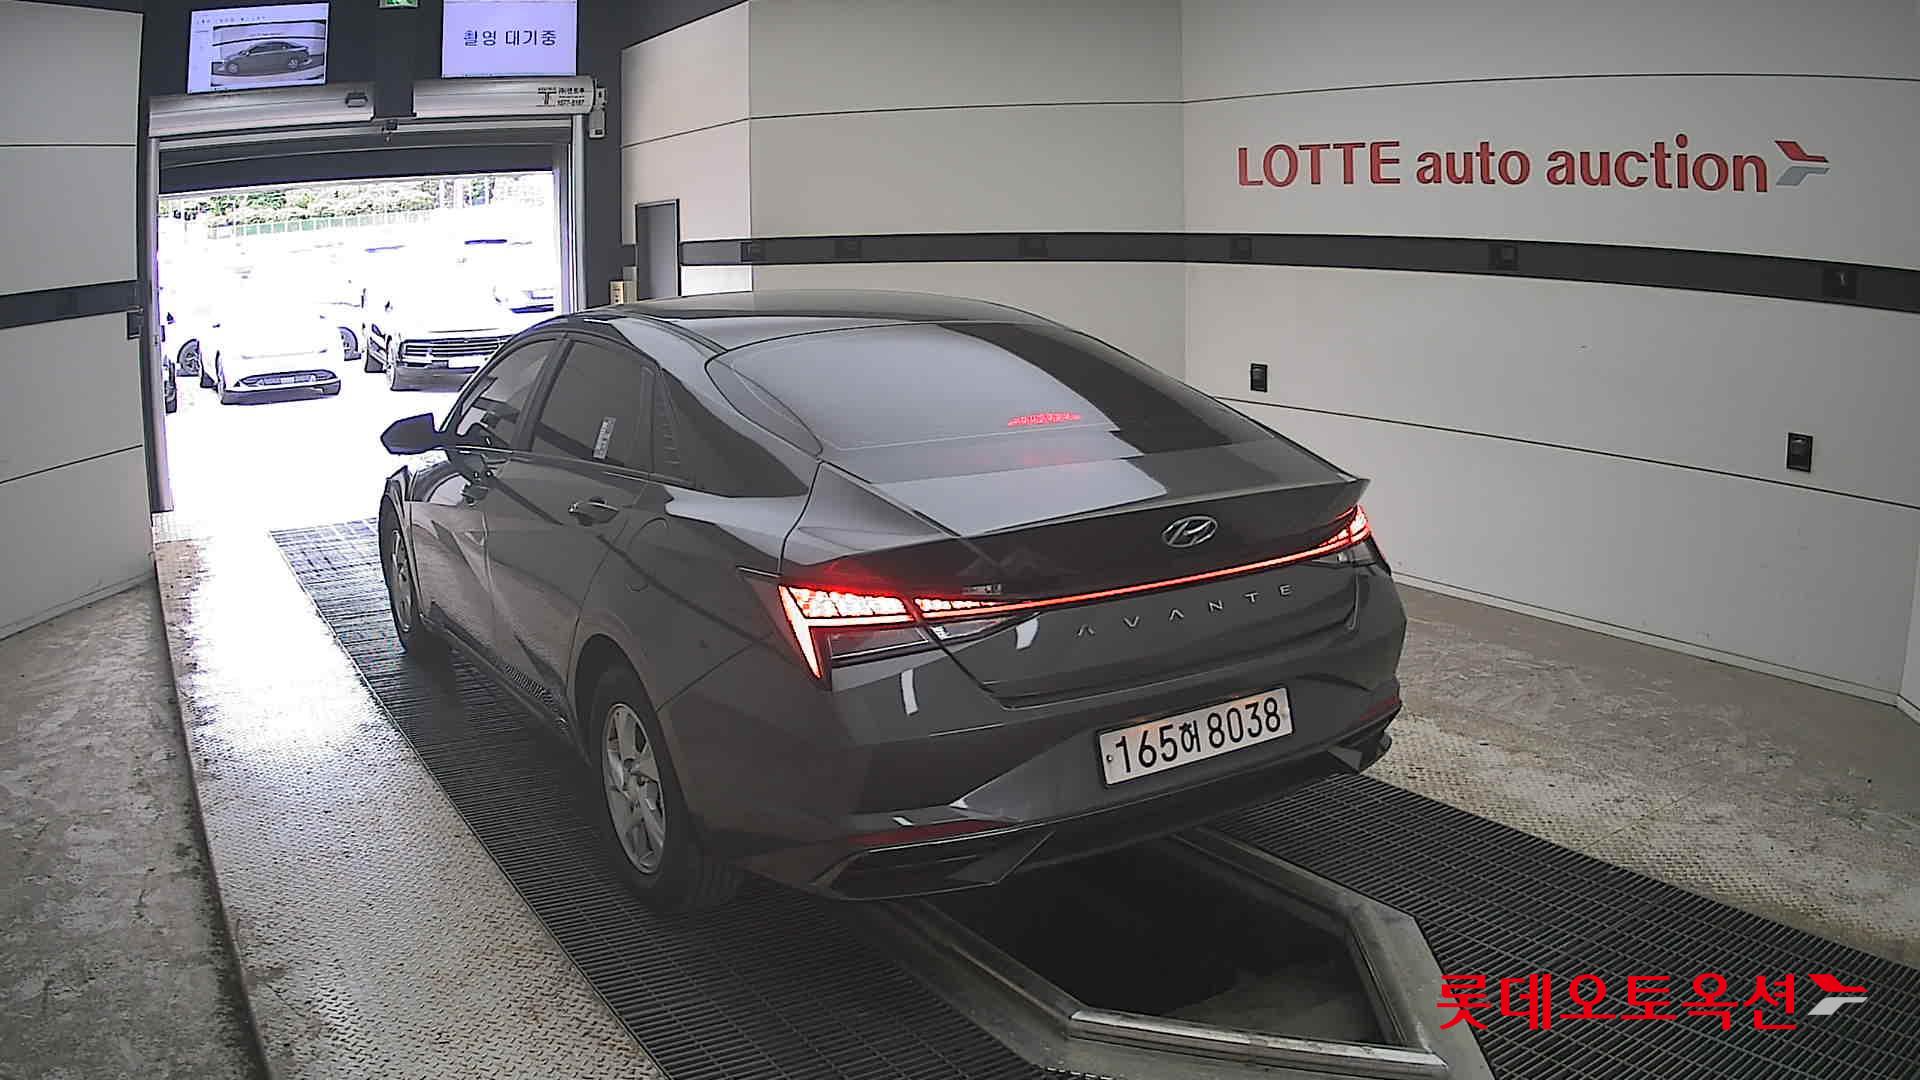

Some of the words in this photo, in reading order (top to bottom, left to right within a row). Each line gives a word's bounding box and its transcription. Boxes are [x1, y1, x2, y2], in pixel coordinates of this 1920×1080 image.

[464, 30, 497, 47] 촬영
[505, 30, 557, 46] 대기중
[1237, 141, 1400, 187] LOTTE
[1416, 142, 1531, 185] auto
[1546, 134, 1768, 192] auction
[1076, 584, 1294, 638] AVANTE
[1206, 697, 1281, 749] 8038
